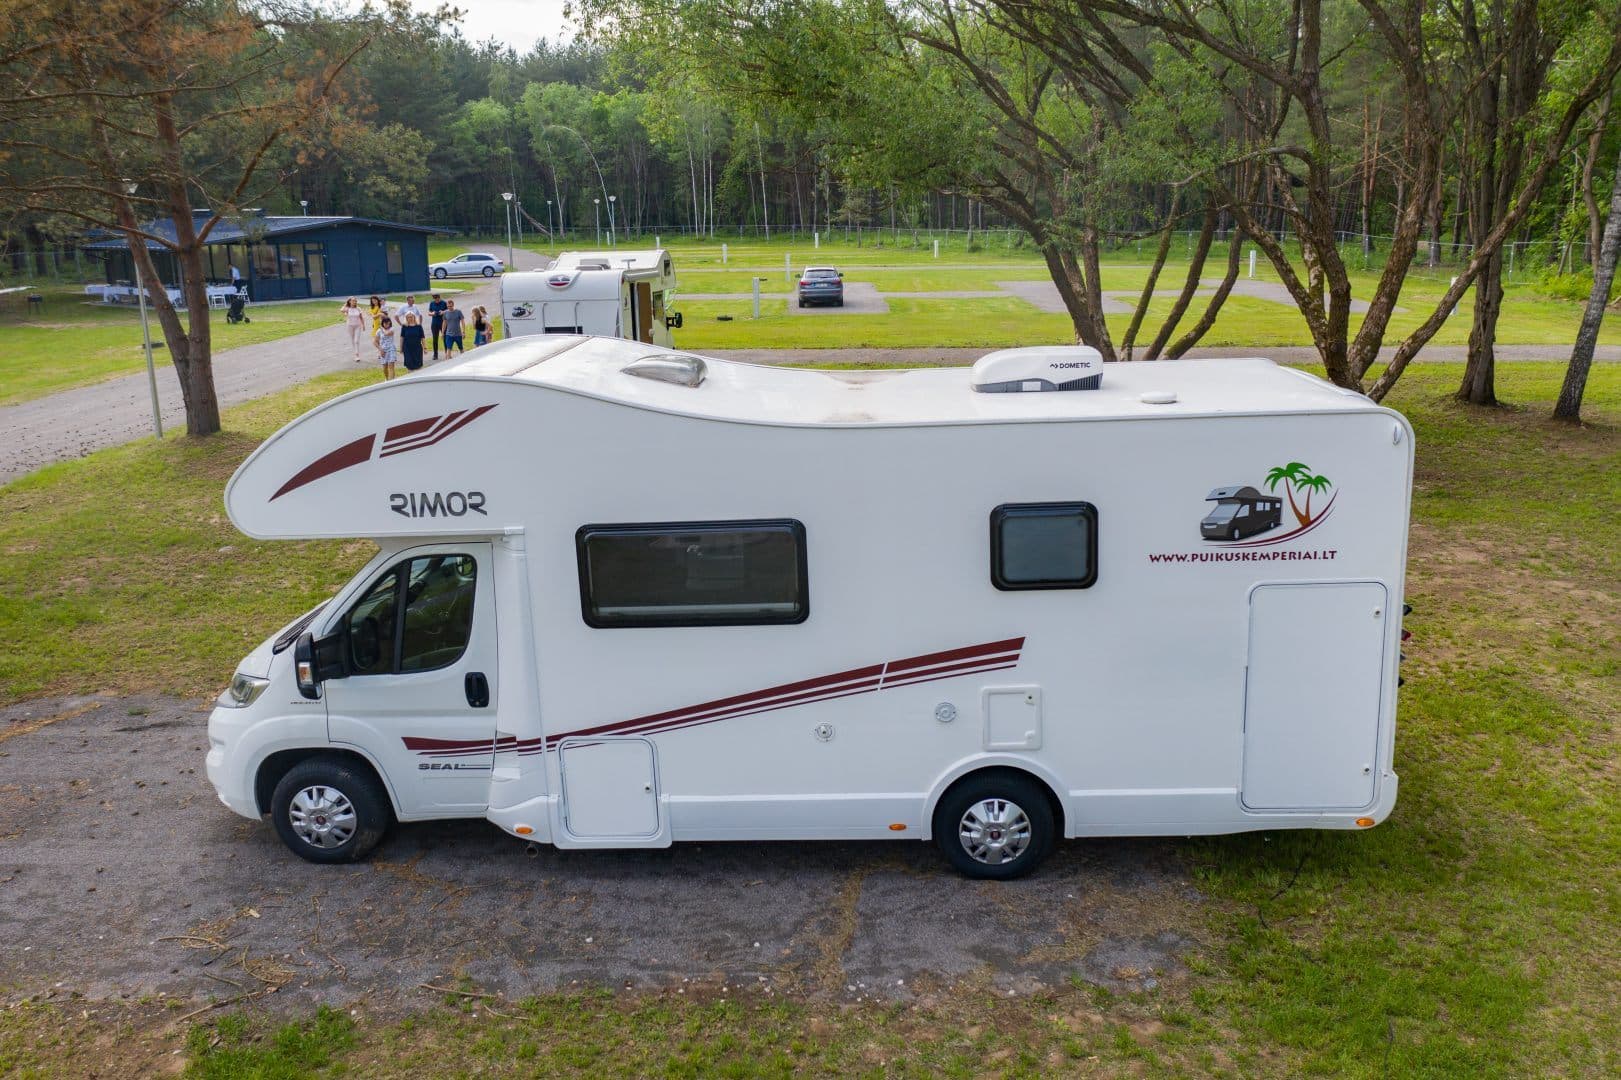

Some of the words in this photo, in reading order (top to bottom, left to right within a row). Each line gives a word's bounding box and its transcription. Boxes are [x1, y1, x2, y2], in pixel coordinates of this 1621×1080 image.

[389, 491, 488, 518] RIMOR
[1149, 550, 1338, 563] WWW.PUIKUSKEMPERIAI.LT
[418, 763, 461, 771] SEAL
